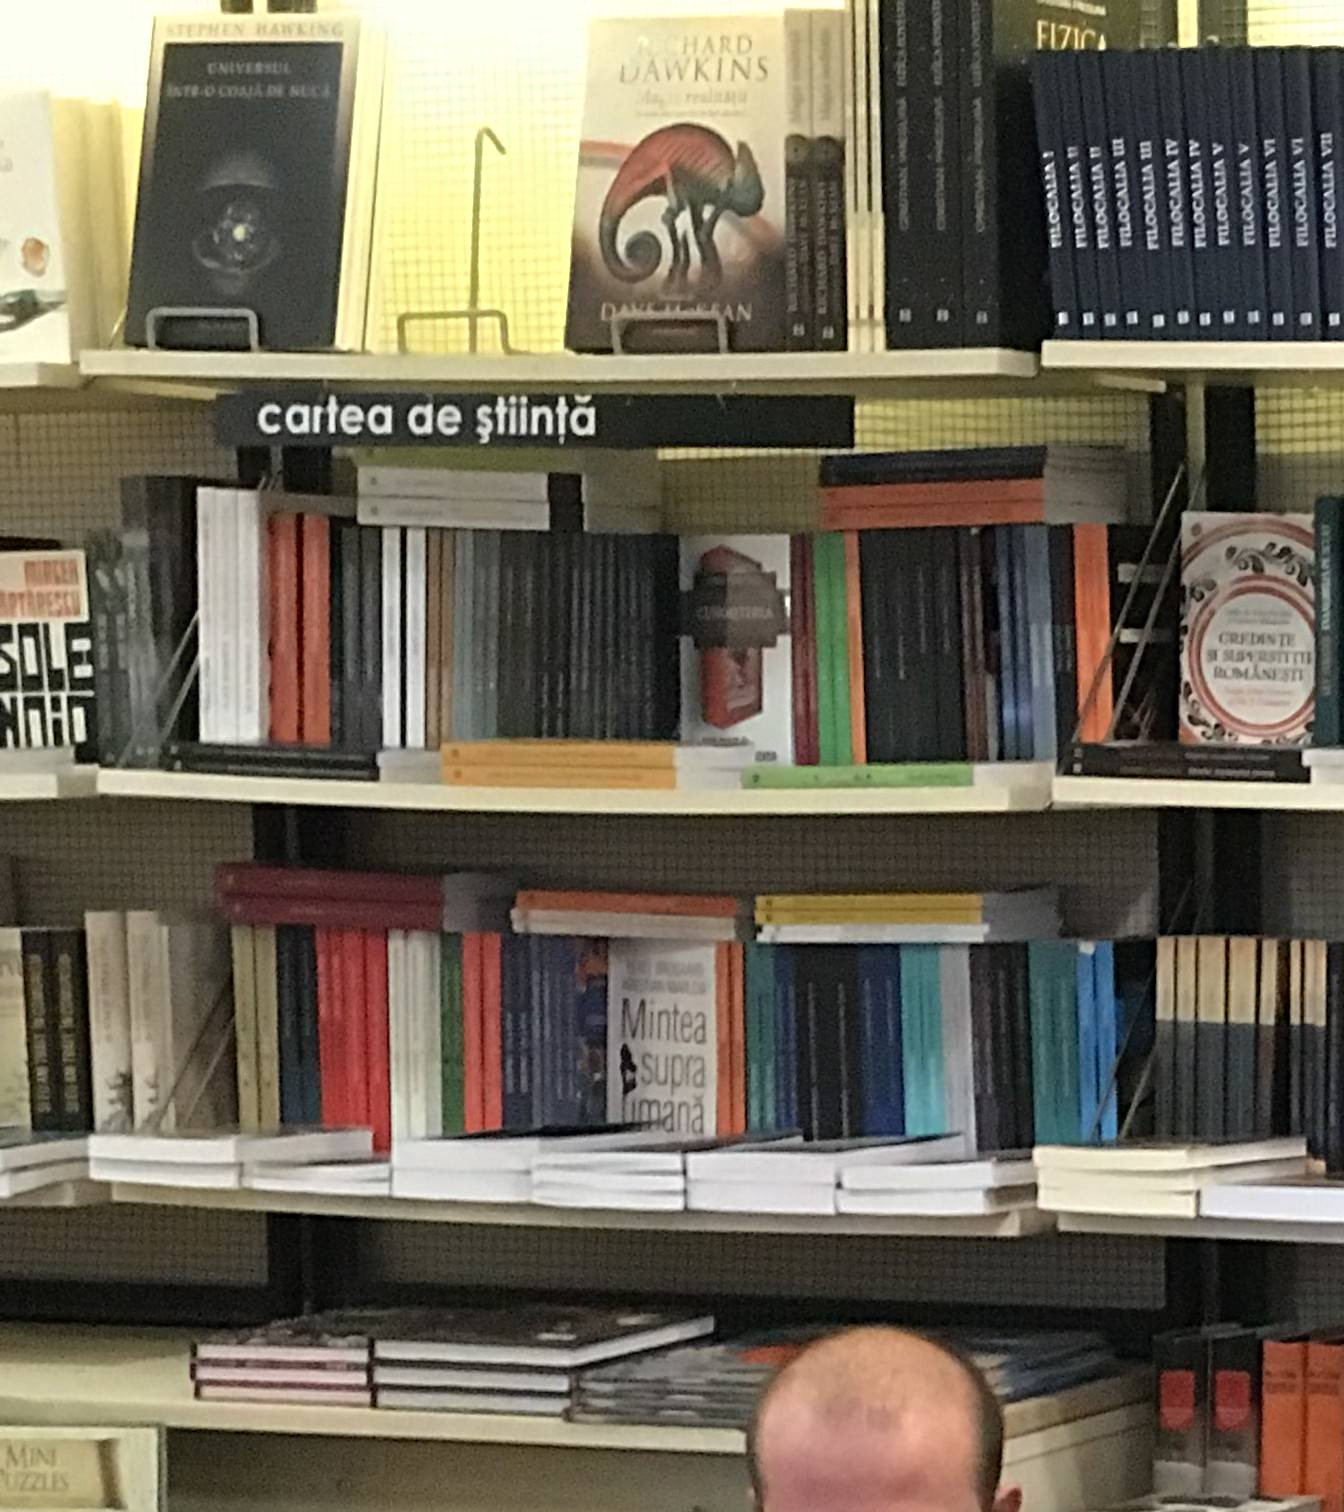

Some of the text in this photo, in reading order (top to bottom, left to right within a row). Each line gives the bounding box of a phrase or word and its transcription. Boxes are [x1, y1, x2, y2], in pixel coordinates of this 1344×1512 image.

[257, 21, 344, 35] HAWKING
[619, 56, 768, 83] DAWKINS
[1045, 162, 1061, 248] FILOCALIA
[1069, 162, 1087, 248] FILOCALIA
[1092, 163, 1109, 249] FILOCALIA
[1115, 161, 1132, 247] FILOCALIA
[1142, 164, 1159, 250] FILOCALIA
[1168, 159, 1184, 246] FILOCALIA
[1191, 161, 1206, 248] FILOCALIA
[1214, 159, 1229, 245] FILOCALIA
[1240, 159, 1255, 245] FILOCALIA
[1266, 160, 1280, 247] FILOCALIA
[1294, 160, 1308, 246] FILOCALIA
[1322, 161, 1336, 248] FILOCALIA
[258, 394, 598, 442] cartea de ştiinţă
[621, 998, 707, 1045] Mintea
[641, 1051, 705, 1094] supra
[5, 1442, 57, 1468] MINI
